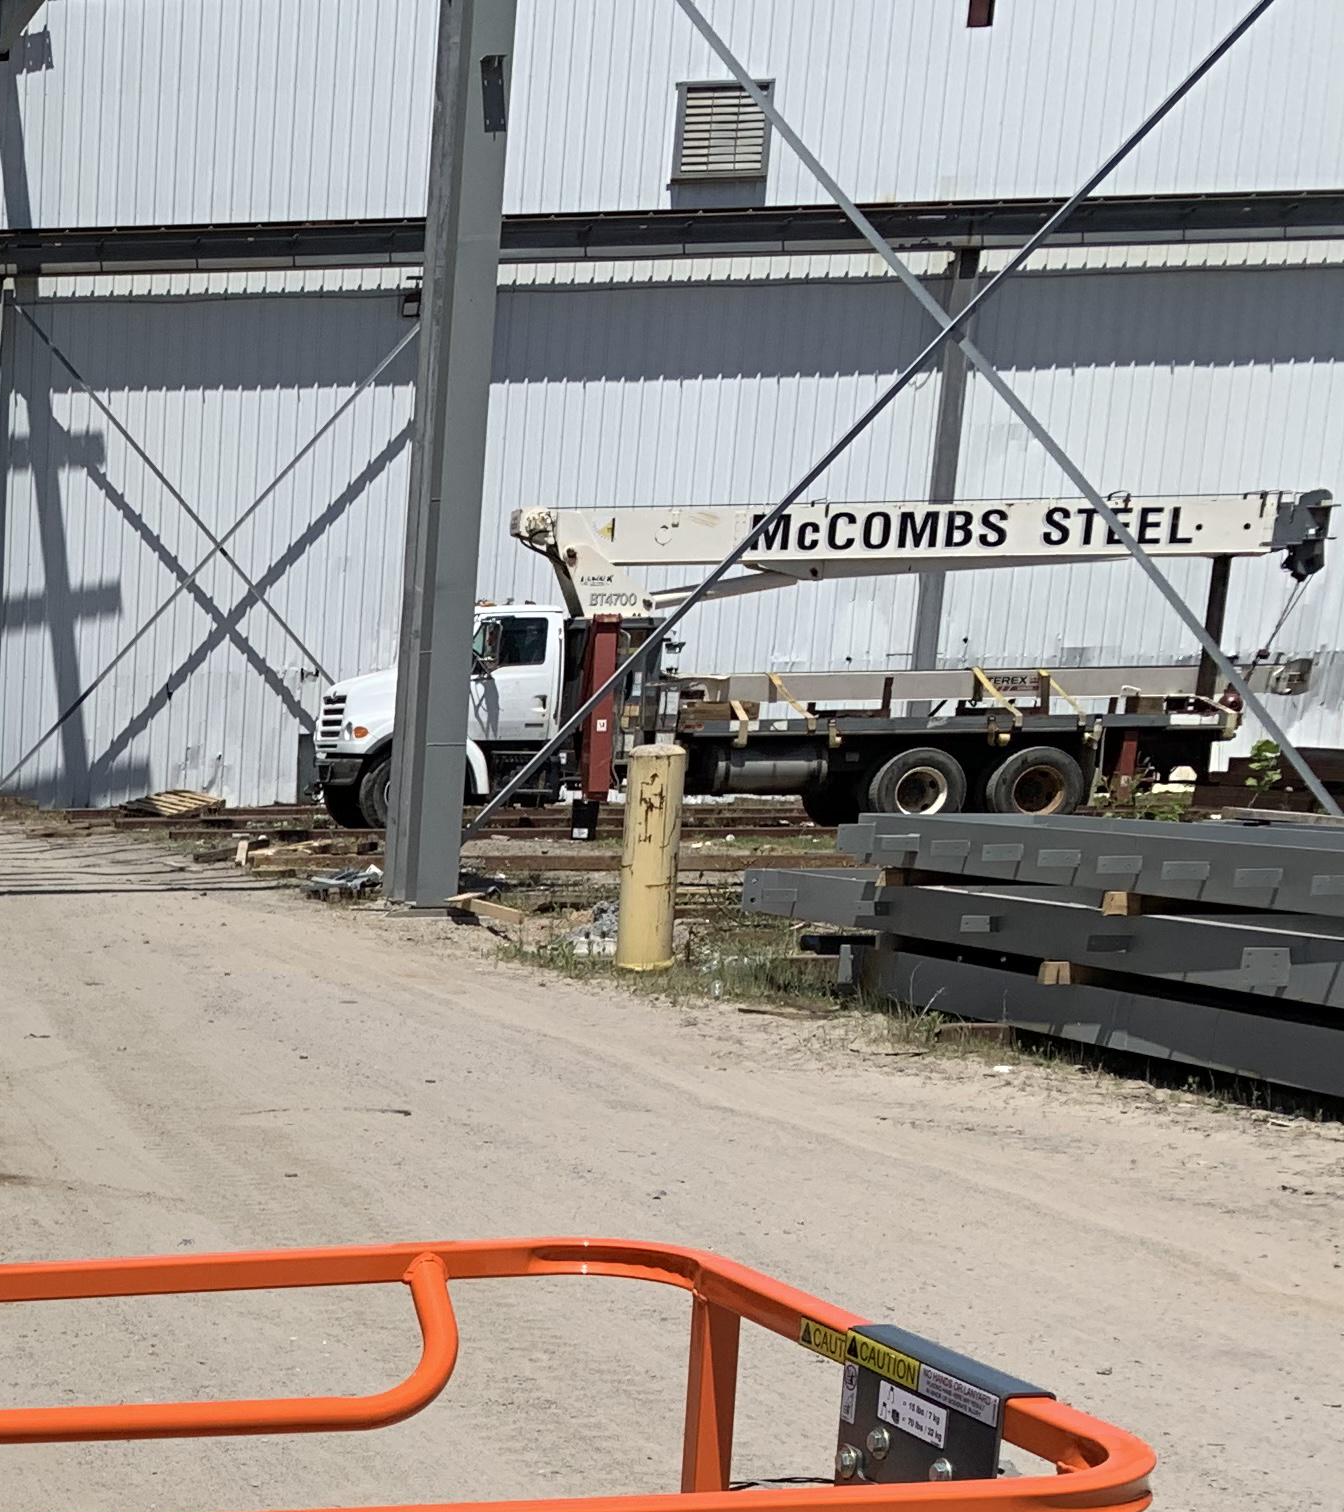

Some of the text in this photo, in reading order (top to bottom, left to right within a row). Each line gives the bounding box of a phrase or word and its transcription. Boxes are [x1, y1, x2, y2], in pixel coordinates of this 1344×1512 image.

[750, 506, 1193, 551] McCOMBS STEEL
[589, 592, 638, 607] BT4700
[813, 1328, 845, 1358] CAUT
[860, 1342, 915, 1385] CAUTION
